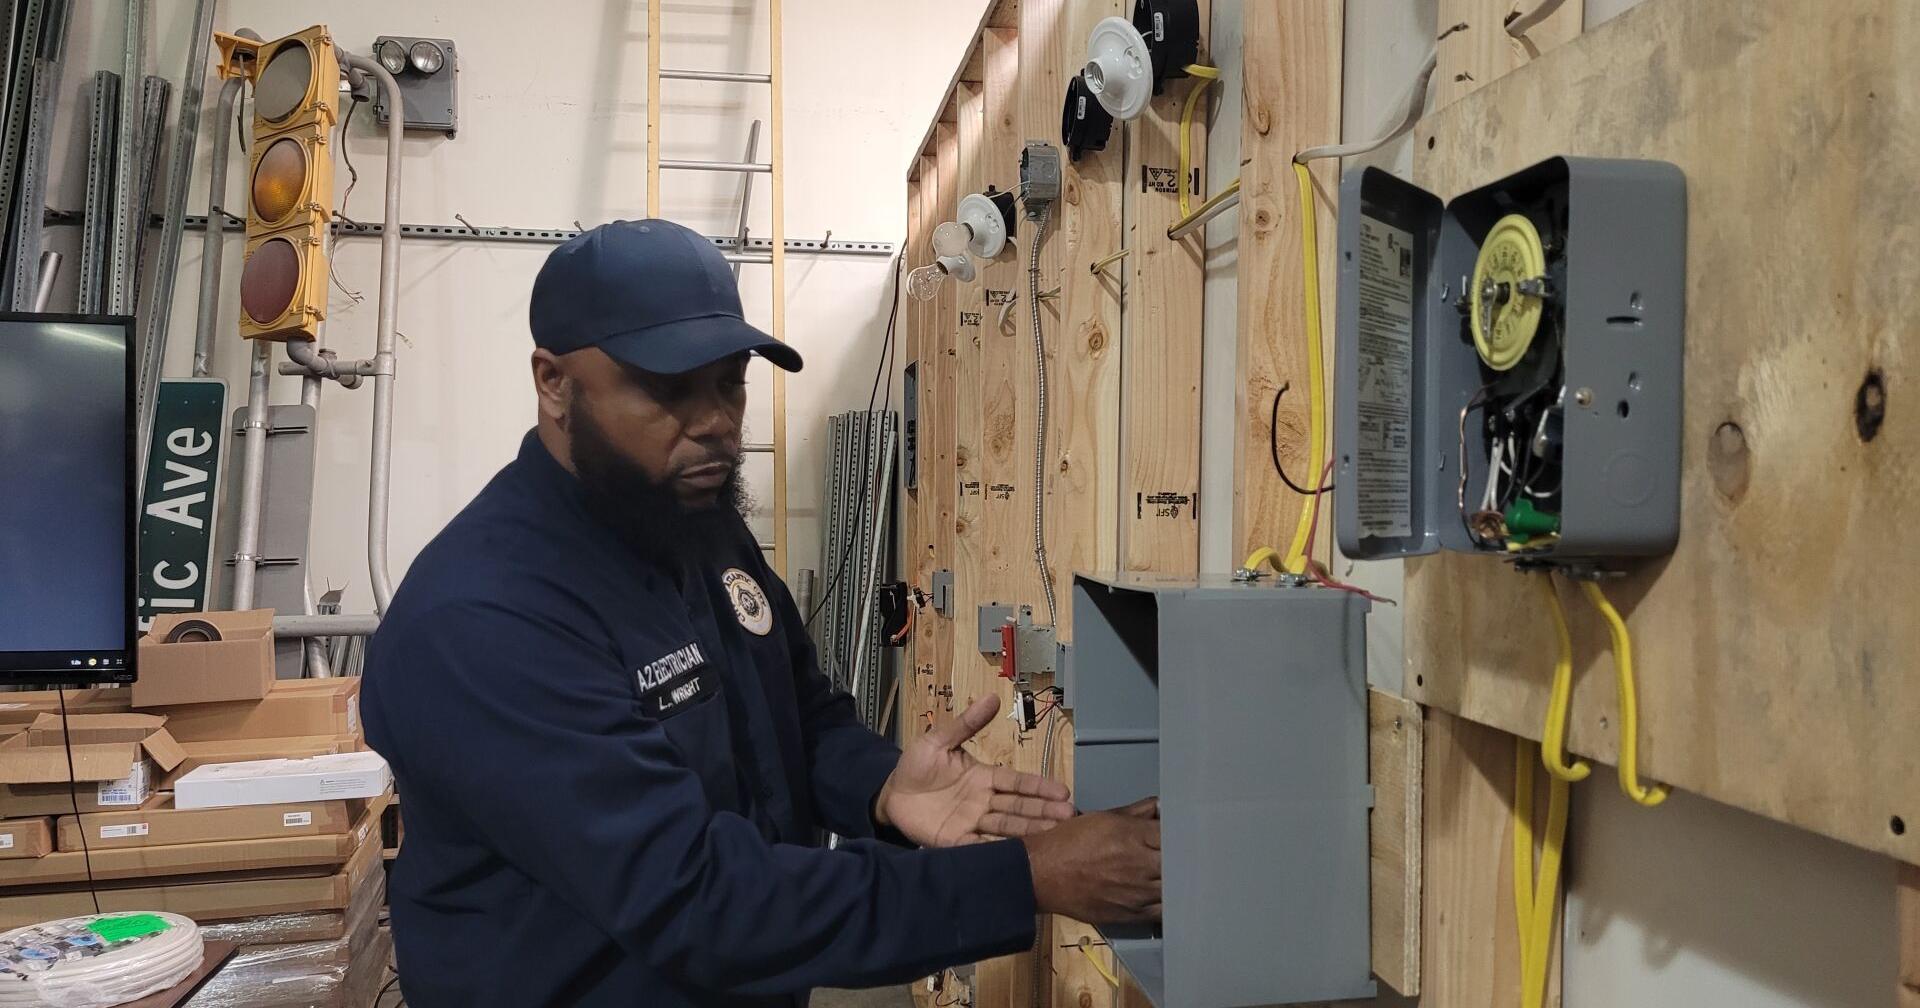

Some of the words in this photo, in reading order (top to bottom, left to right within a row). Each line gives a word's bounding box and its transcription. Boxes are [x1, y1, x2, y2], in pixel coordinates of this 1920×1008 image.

[146, 427, 212, 529] Ave
[637, 665, 657, 693] A2
[651, 642, 704, 686] ELECTRICIAN
[671, 677, 701, 705] WRIGHT
